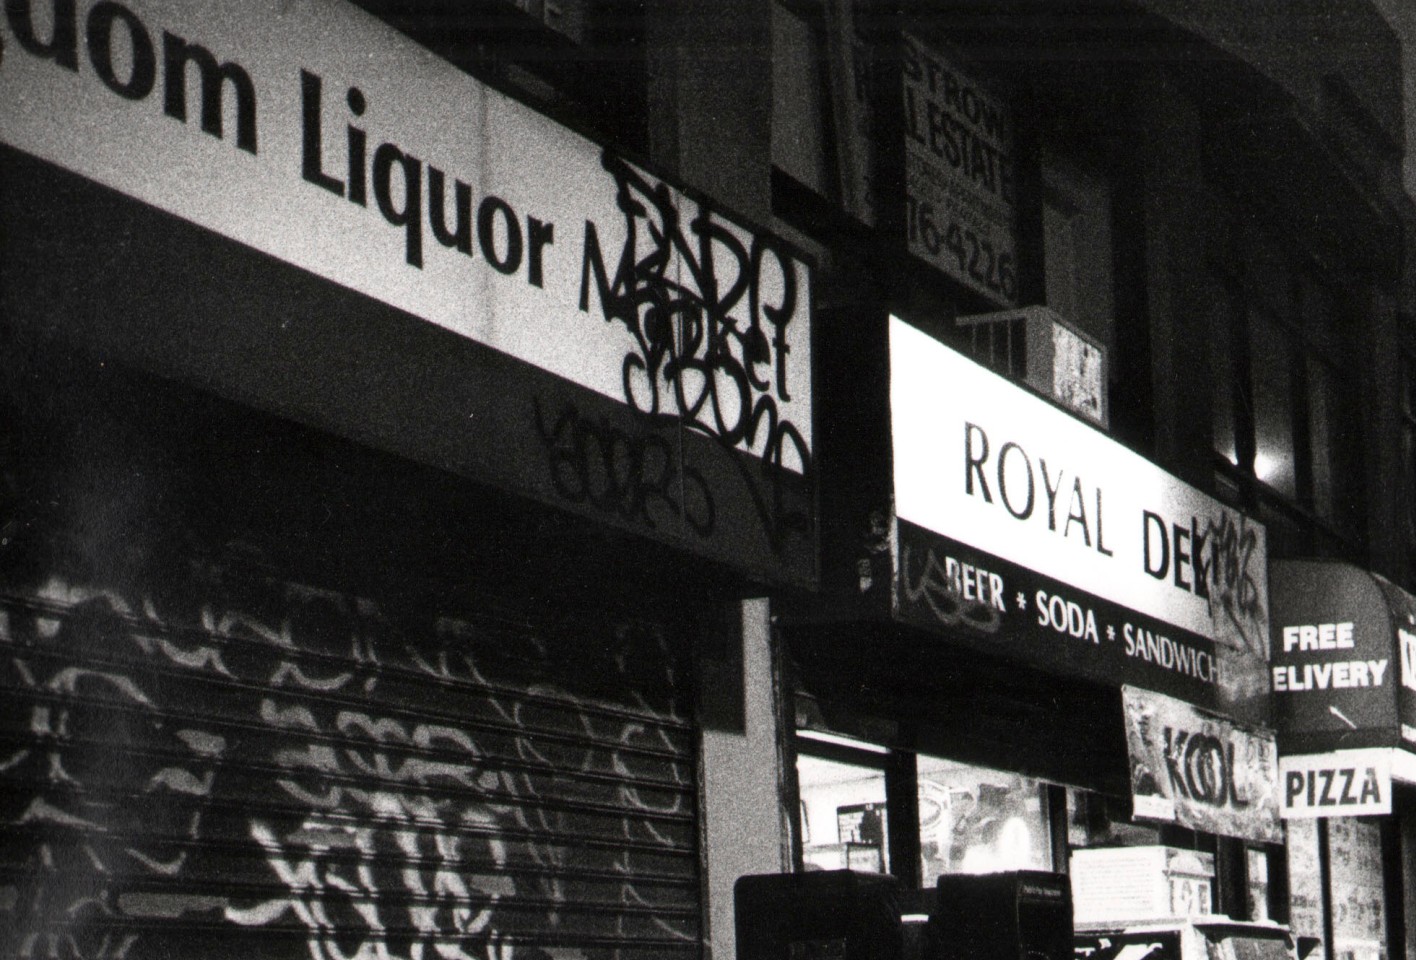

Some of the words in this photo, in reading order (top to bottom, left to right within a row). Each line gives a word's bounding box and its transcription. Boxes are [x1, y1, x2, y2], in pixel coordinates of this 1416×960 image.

[0, 0, 258, 156] dom
[300, 67, 554, 289] Liquor
[964, 420, 1114, 558] ROYAL
[945, 555, 1006, 613] BEER
[1036, 589, 1100, 644] SODA
[1283, 621, 1355, 653] FREE
[1272, 659, 1388, 692] ELIVERY
[1163, 726, 1250, 807] KOOL
[1286, 767, 1381, 809] PIZZA
